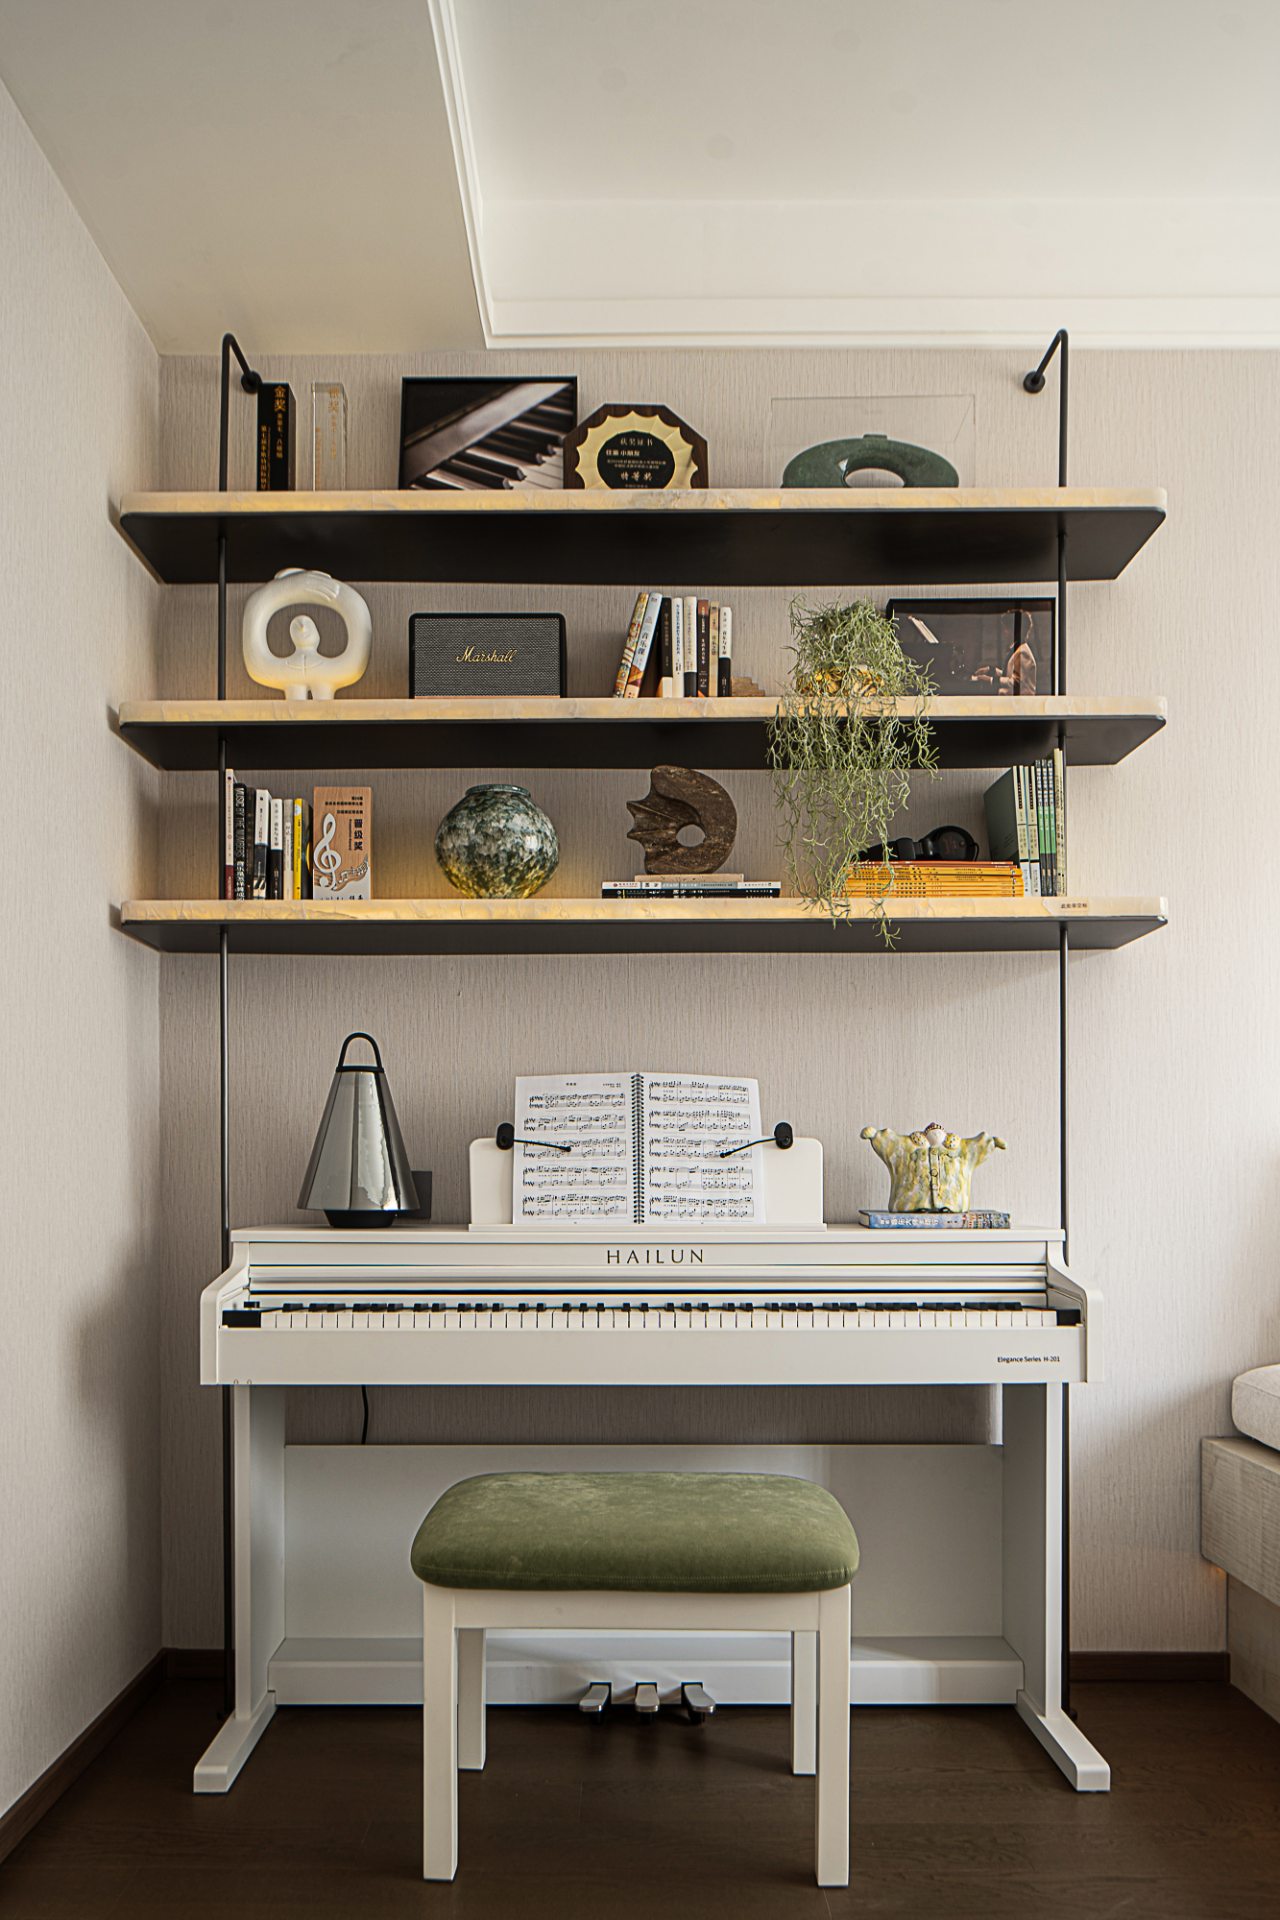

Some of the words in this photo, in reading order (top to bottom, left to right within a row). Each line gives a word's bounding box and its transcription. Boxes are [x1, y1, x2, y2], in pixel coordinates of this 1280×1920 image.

[274, 385, 286, 412] 金奖
[456, 645, 518, 663] Marshall
[235, 787, 245, 808] MUSIC
[235, 808, 245, 817] BY
[235, 817, 245, 829] THE
[235, 829, 245, 858] NUMBERS
[354, 819, 363, 851] 晋级奖
[607, 1249, 704, 1264] HAILUN
[997, 1356, 1024, 1364] Elegance
[1043, 1355, 1060, 1363] H-201
